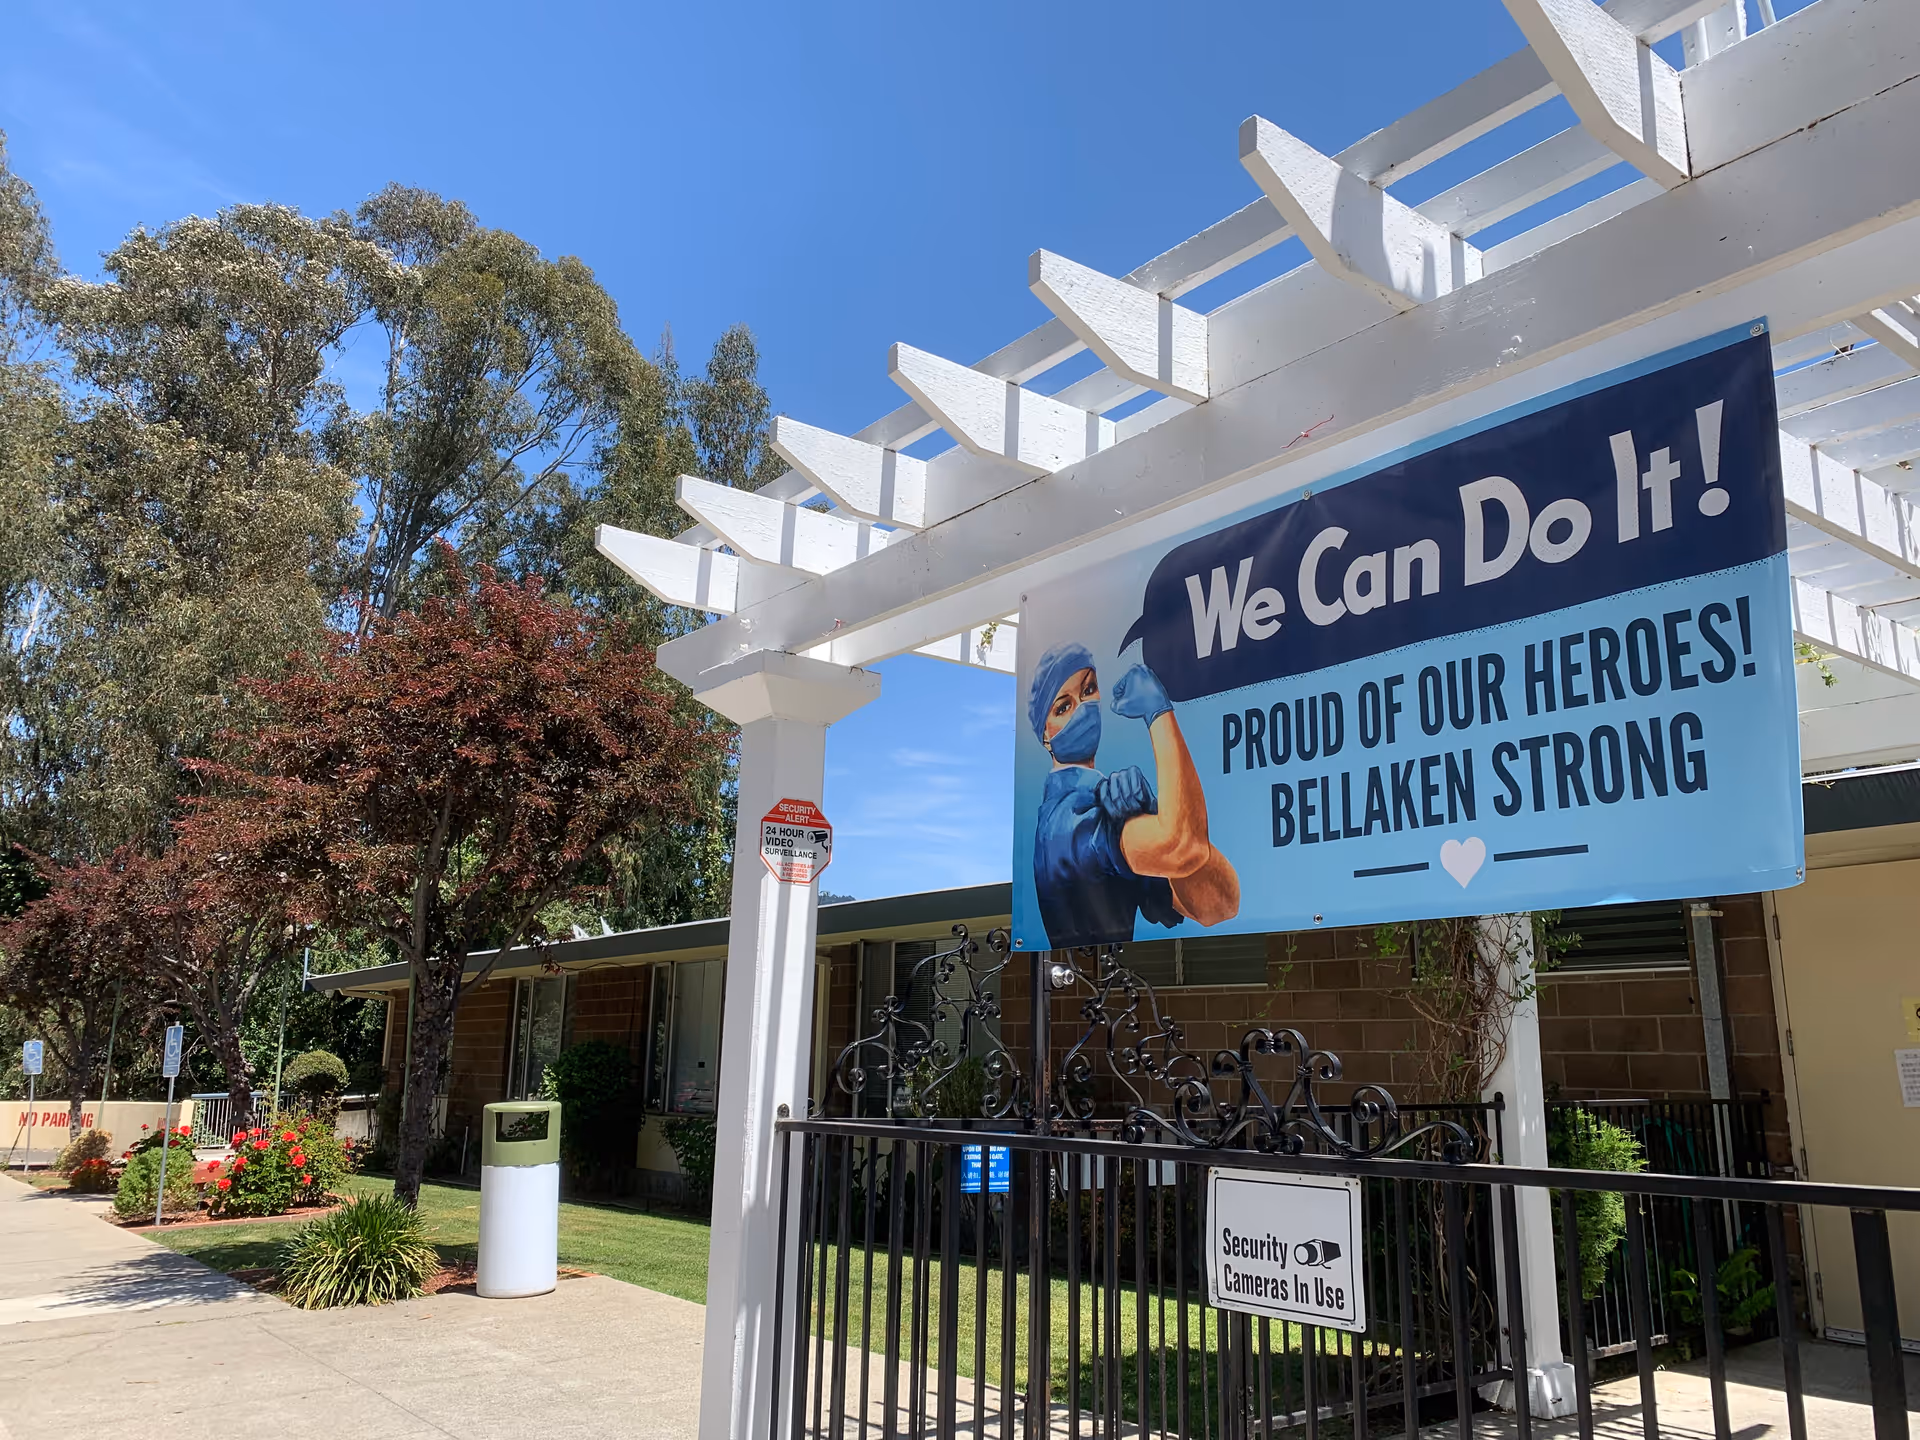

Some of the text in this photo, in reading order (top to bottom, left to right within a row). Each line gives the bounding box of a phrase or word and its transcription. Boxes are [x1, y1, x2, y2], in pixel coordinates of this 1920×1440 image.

[1185, 556, 1286, 660] We
[1297, 526, 1441, 626] Can
[1458, 475, 1592, 587] Do
[1222, 595, 1758, 775] PROUD OF OUR HEROES!
[1271, 711, 1709, 848] BELLAKEN STRONG
[779, 803, 816, 815] SECURITY
[785, 814, 809, 824] ALERT
[765, 826, 804, 839] 24 HOUR
[765, 837, 794, 848] VIDEO
[765, 847, 818, 860] SURVEILLANCE
[41, 1112, 94, 1128] PARNG
[1222, 1227, 1288, 1270] Security
[1223, 1263, 1289, 1302] Cameras
[1294, 1273, 1310, 1304] In
[1314, 1276, 1345, 1311] Use
